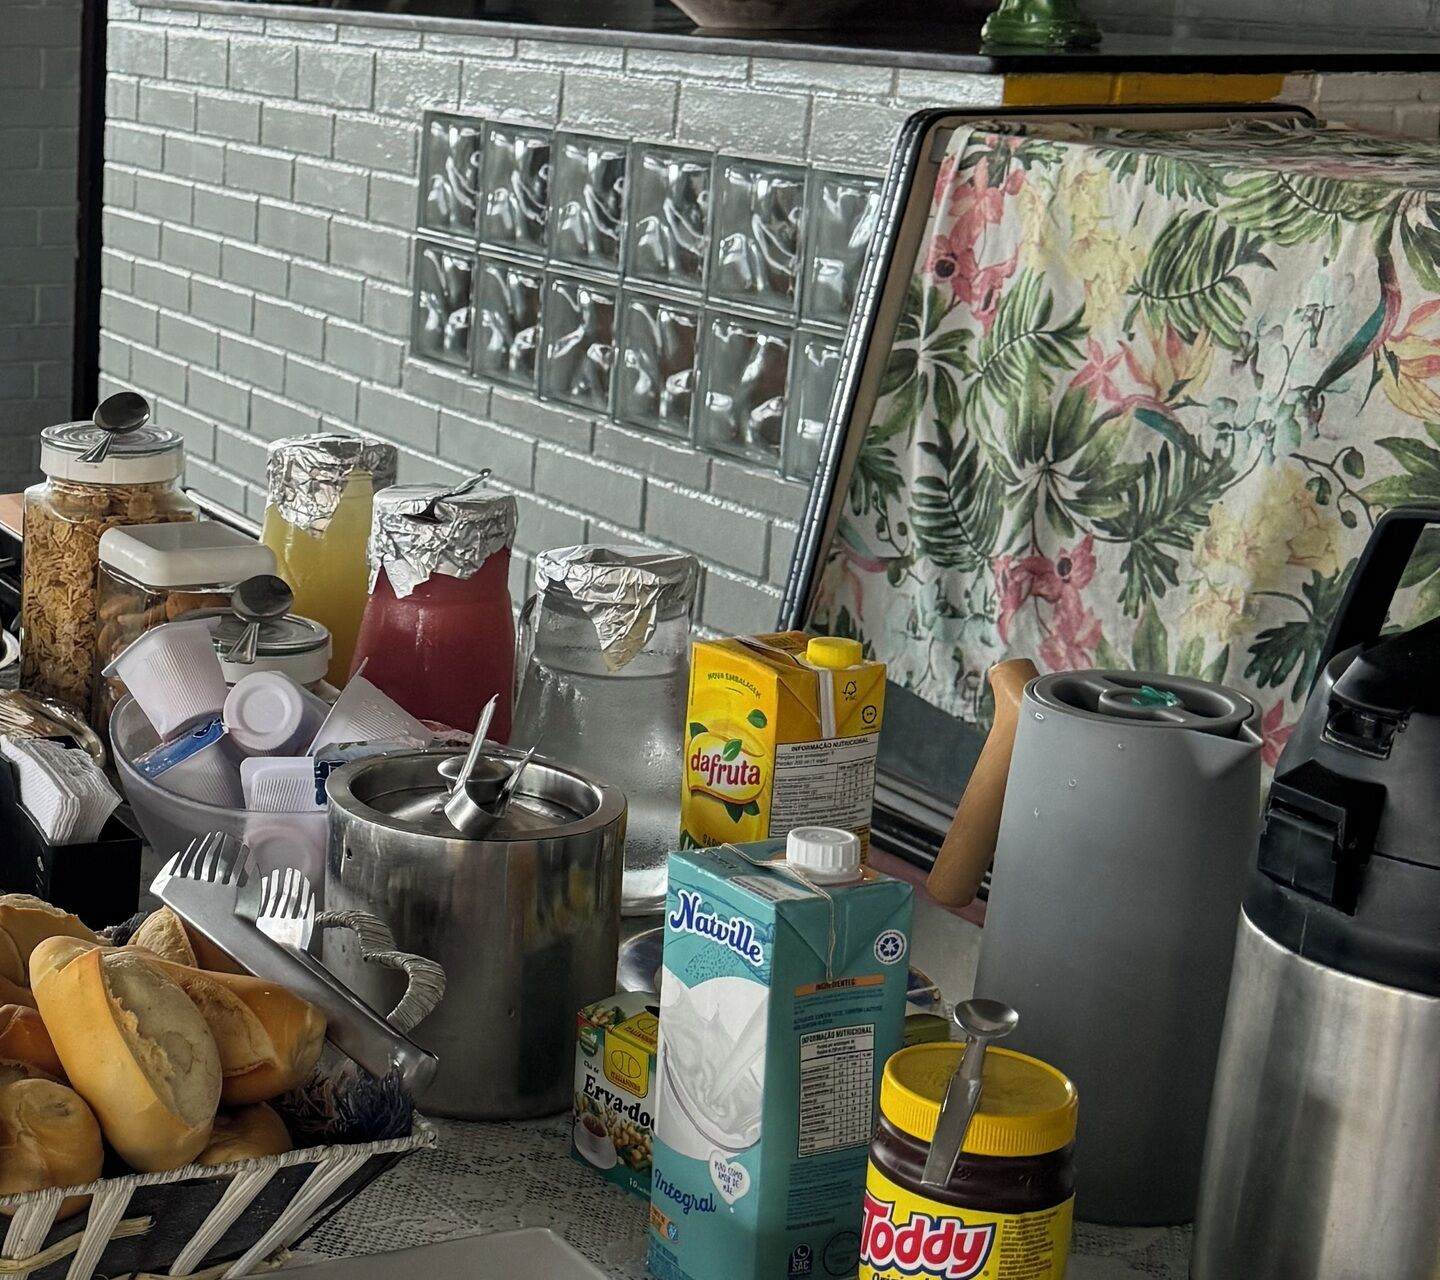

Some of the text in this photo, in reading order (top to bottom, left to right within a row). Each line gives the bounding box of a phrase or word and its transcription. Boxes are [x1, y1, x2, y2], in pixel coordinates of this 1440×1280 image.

[707, 672, 762, 700] NOVA EMBALAGEM
[690, 748, 761, 786] dafruta
[669, 891, 763, 964] Natville
[654, 1169, 717, 1215] Integral
[861, 1194, 988, 1275] Toddy
[792, 1260, 810, 1272] SAC
